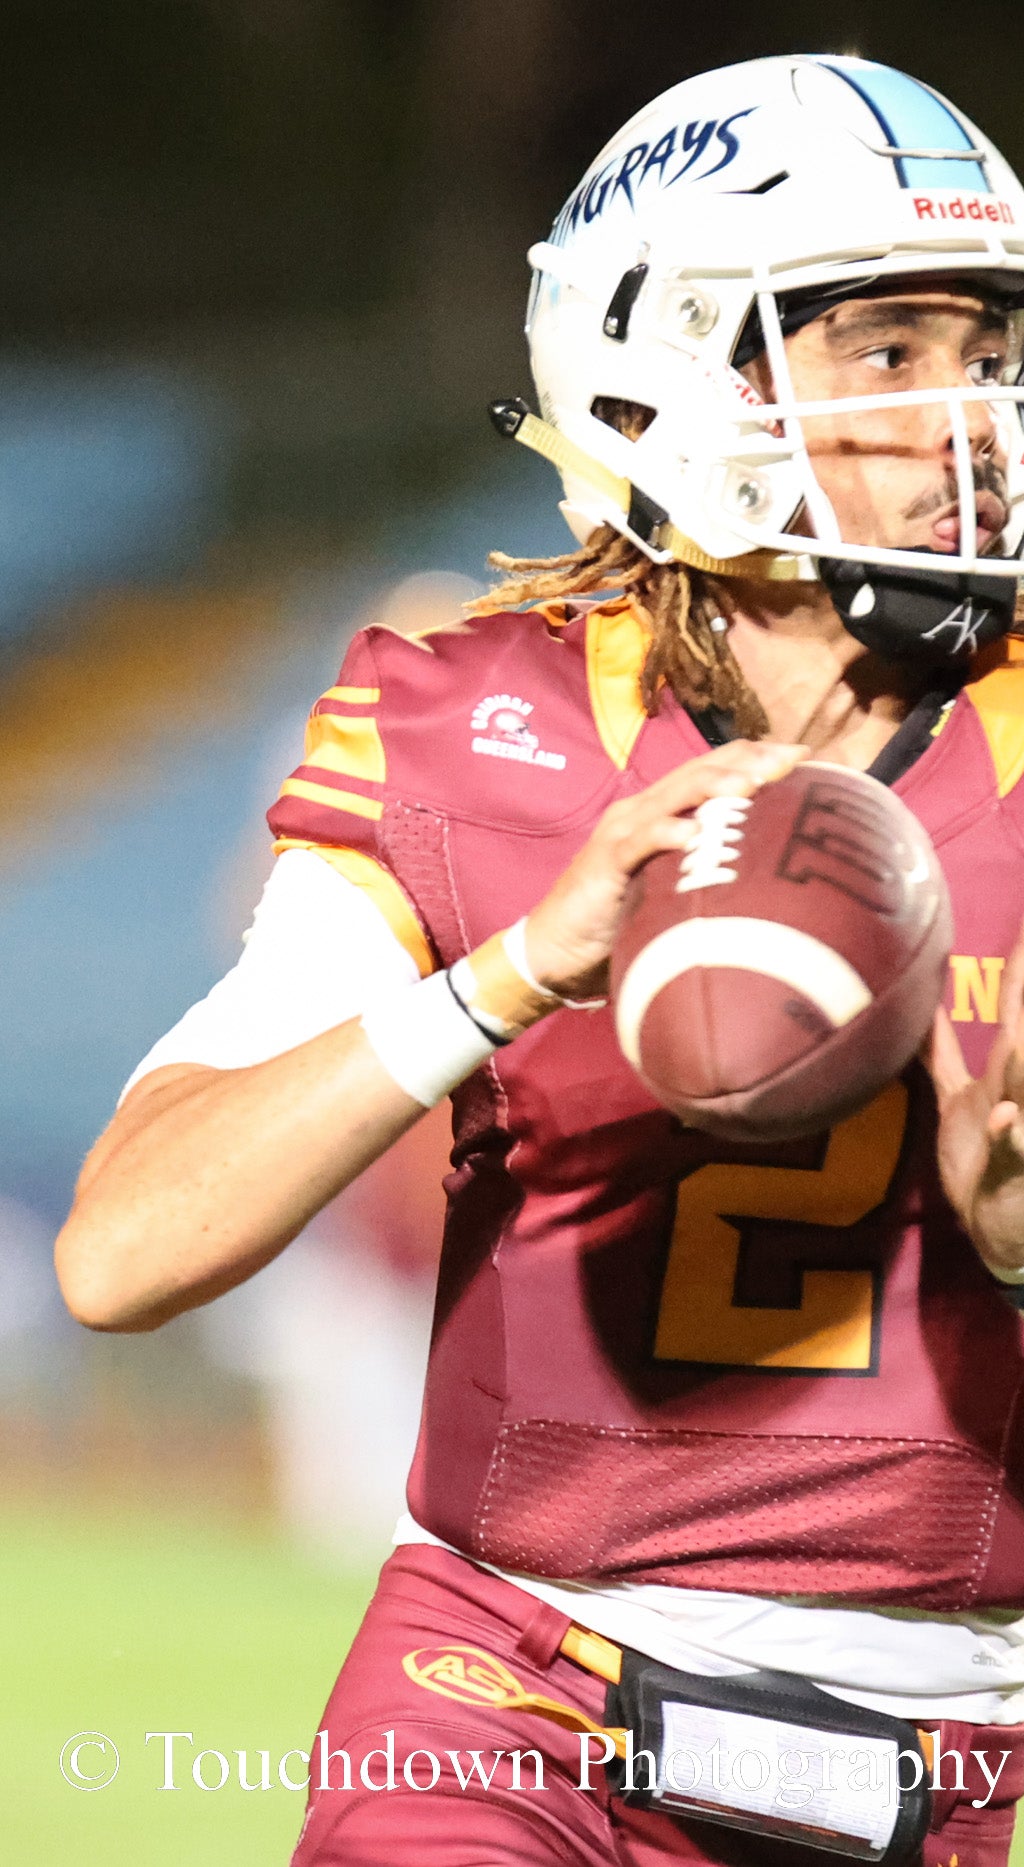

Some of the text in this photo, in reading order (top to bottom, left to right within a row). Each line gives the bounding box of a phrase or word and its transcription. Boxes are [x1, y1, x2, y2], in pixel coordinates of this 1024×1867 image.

[912, 197, 1016, 225] Riddell
[470, 736, 567, 770] QUEENSLAND
[645, 1082, 912, 1375] 2
